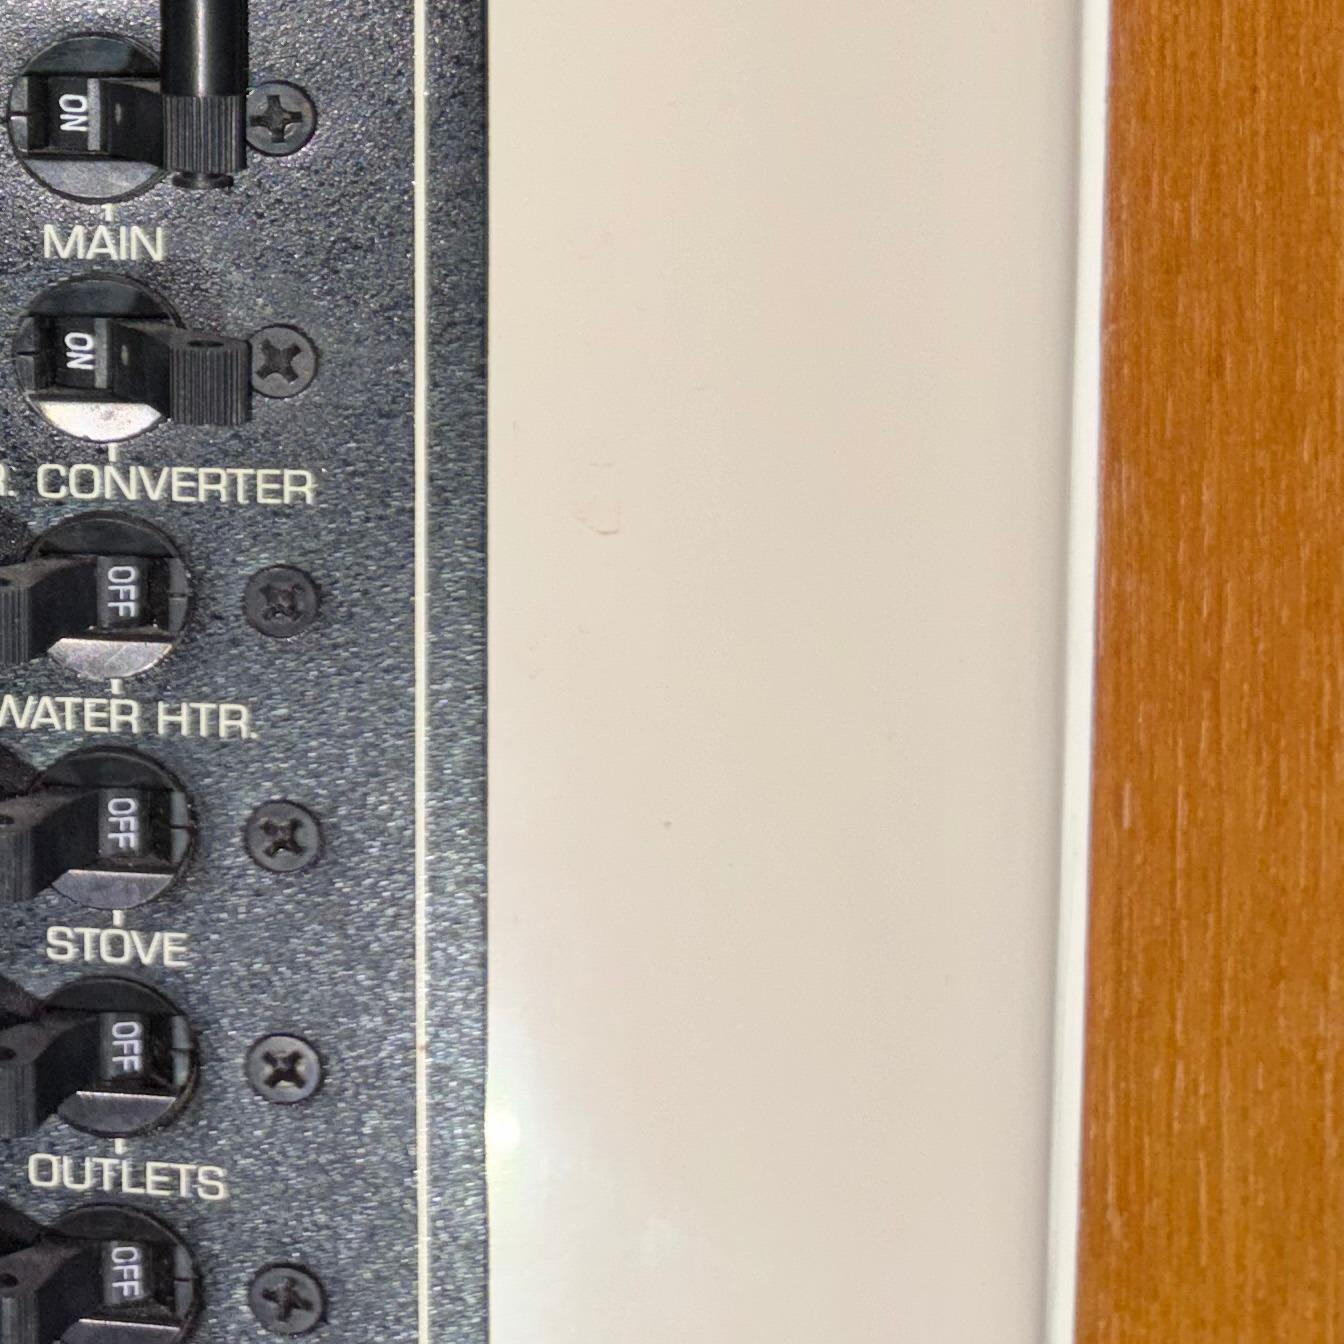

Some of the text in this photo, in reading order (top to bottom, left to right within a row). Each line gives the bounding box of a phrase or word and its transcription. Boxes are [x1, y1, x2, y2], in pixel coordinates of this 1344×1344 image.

[59, 93, 89, 132] ON
[43, 224, 166, 261] MAIN
[64, 331, 95, 370] ON
[37, 462, 316, 504] CONVERTER
[108, 565, 136, 617] OFF
[157, 701, 259, 739] HTR.
[108, 797, 138, 851] OFF
[46, 925, 189, 967] STOVE
[112, 1021, 143, 1074] OFF
[27, 1152, 227, 1201] OUTLETS
[112, 1246, 144, 1298] OFF
